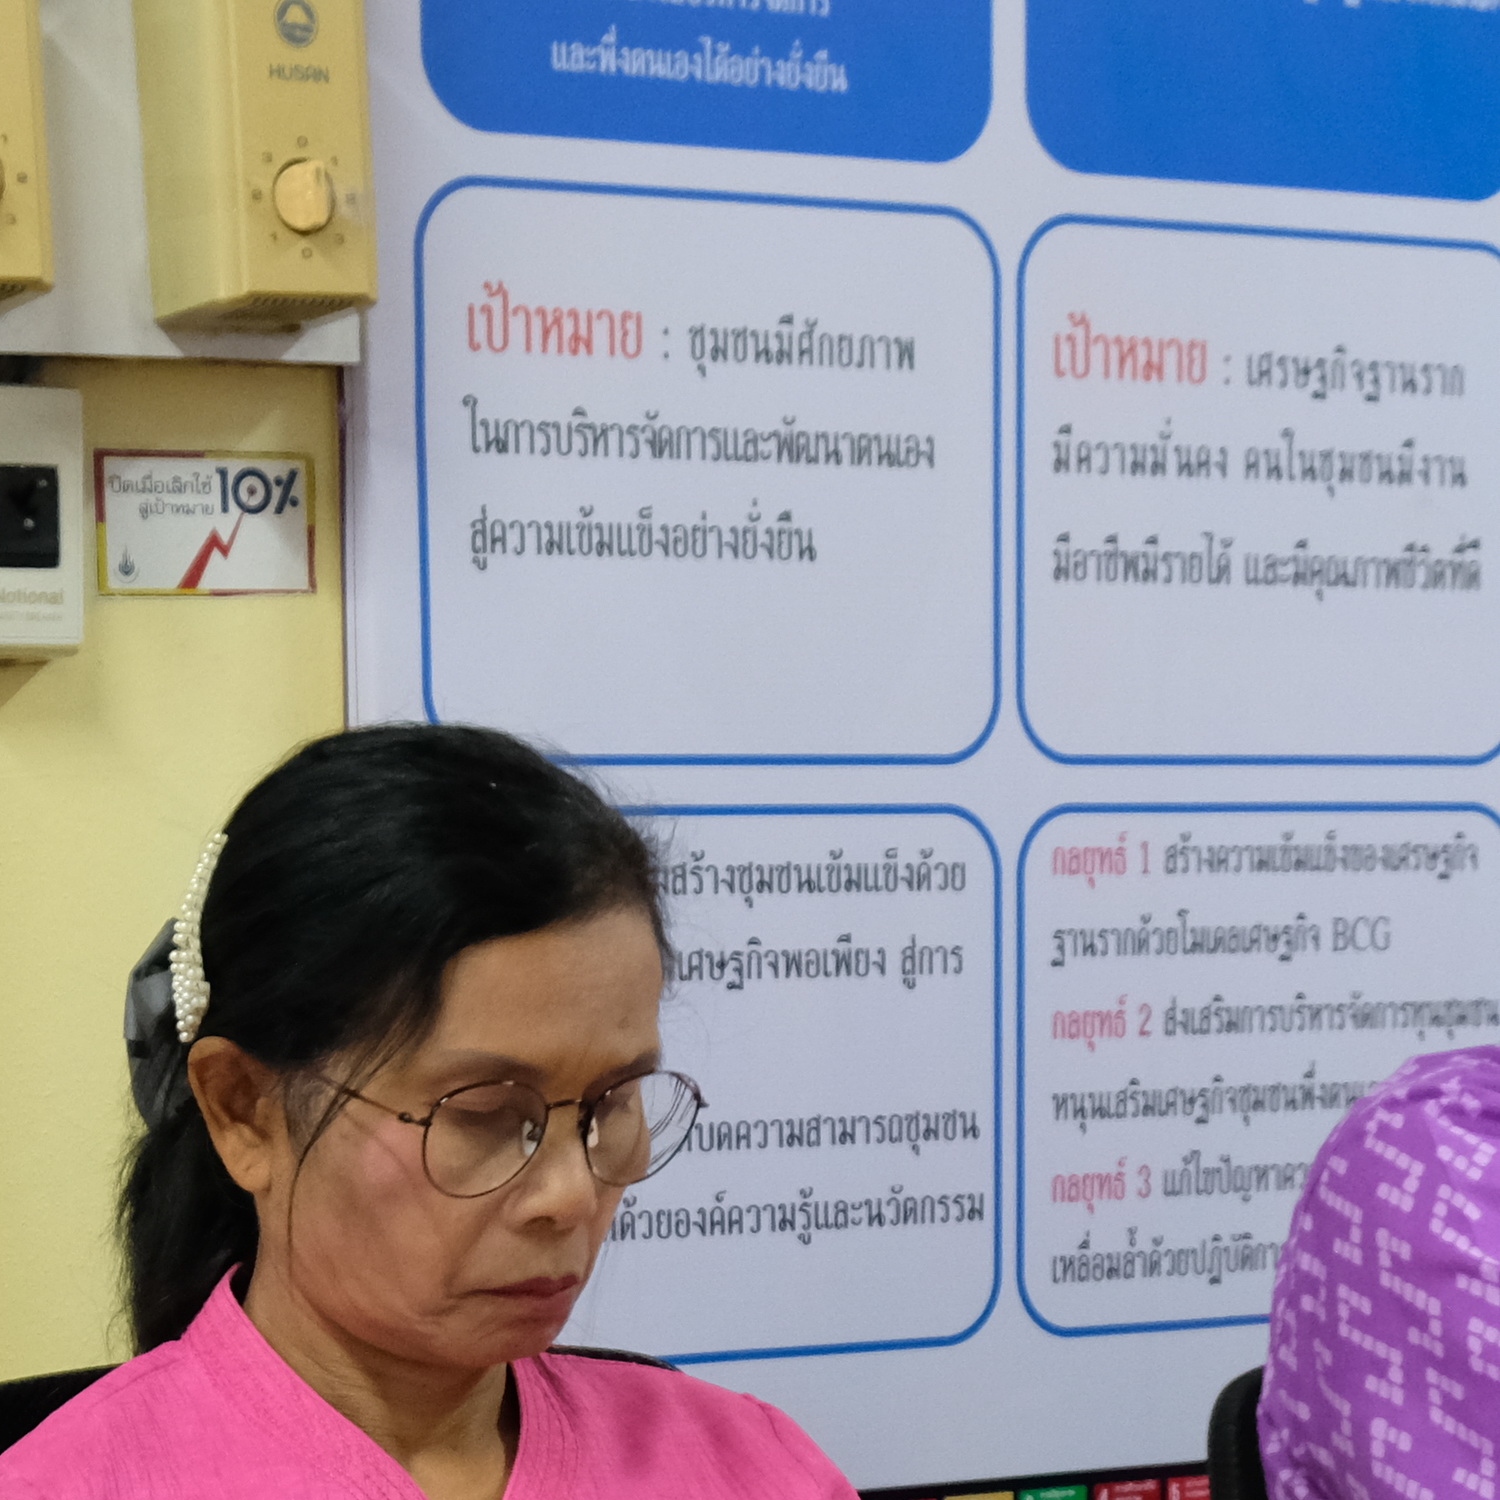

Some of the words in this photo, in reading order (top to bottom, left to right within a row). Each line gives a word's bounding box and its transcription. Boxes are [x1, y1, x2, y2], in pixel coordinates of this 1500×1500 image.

[268, 63, 330, 84] HUSAN
[467, 280, 643, 359] เป้าหมาย
[688, 313, 915, 378] ชุมชนมีศักยภาพ
[1053, 311, 1208, 384] เป้าหมาย
[1246, 343, 1466, 402] เศรษฐกิจฐานราก
[462, 395, 935, 468] ในการบริหารจัดการและพัฒนาตนเอง
[1052, 418, 1228, 478] มีความมั่นคง
[216, 466, 300, 514] 10%
[470, 498, 817, 571] สู่ความเข้มแข็งอย่างยั่งยืน
[1053, 531, 1232, 585] มีอาชีพมีรายได้
[1052, 831, 1128, 889] กลยุทธ์
[1140, 840, 1151, 874] 1
[901, 935, 964, 990] สู่การ
[1331, 915, 1392, 952] BCG
[1052, 994, 1128, 1052] กลยุทธ์
[1138, 1003, 1152, 1037] 2
[1051, 1156, 1126, 1214] กลยุทธ์
[1138, 1164, 1152, 1198] 3
[1052, 1224, 1282, 1286] เหลื่อมล้ำด้วยปฏิบัติกา
